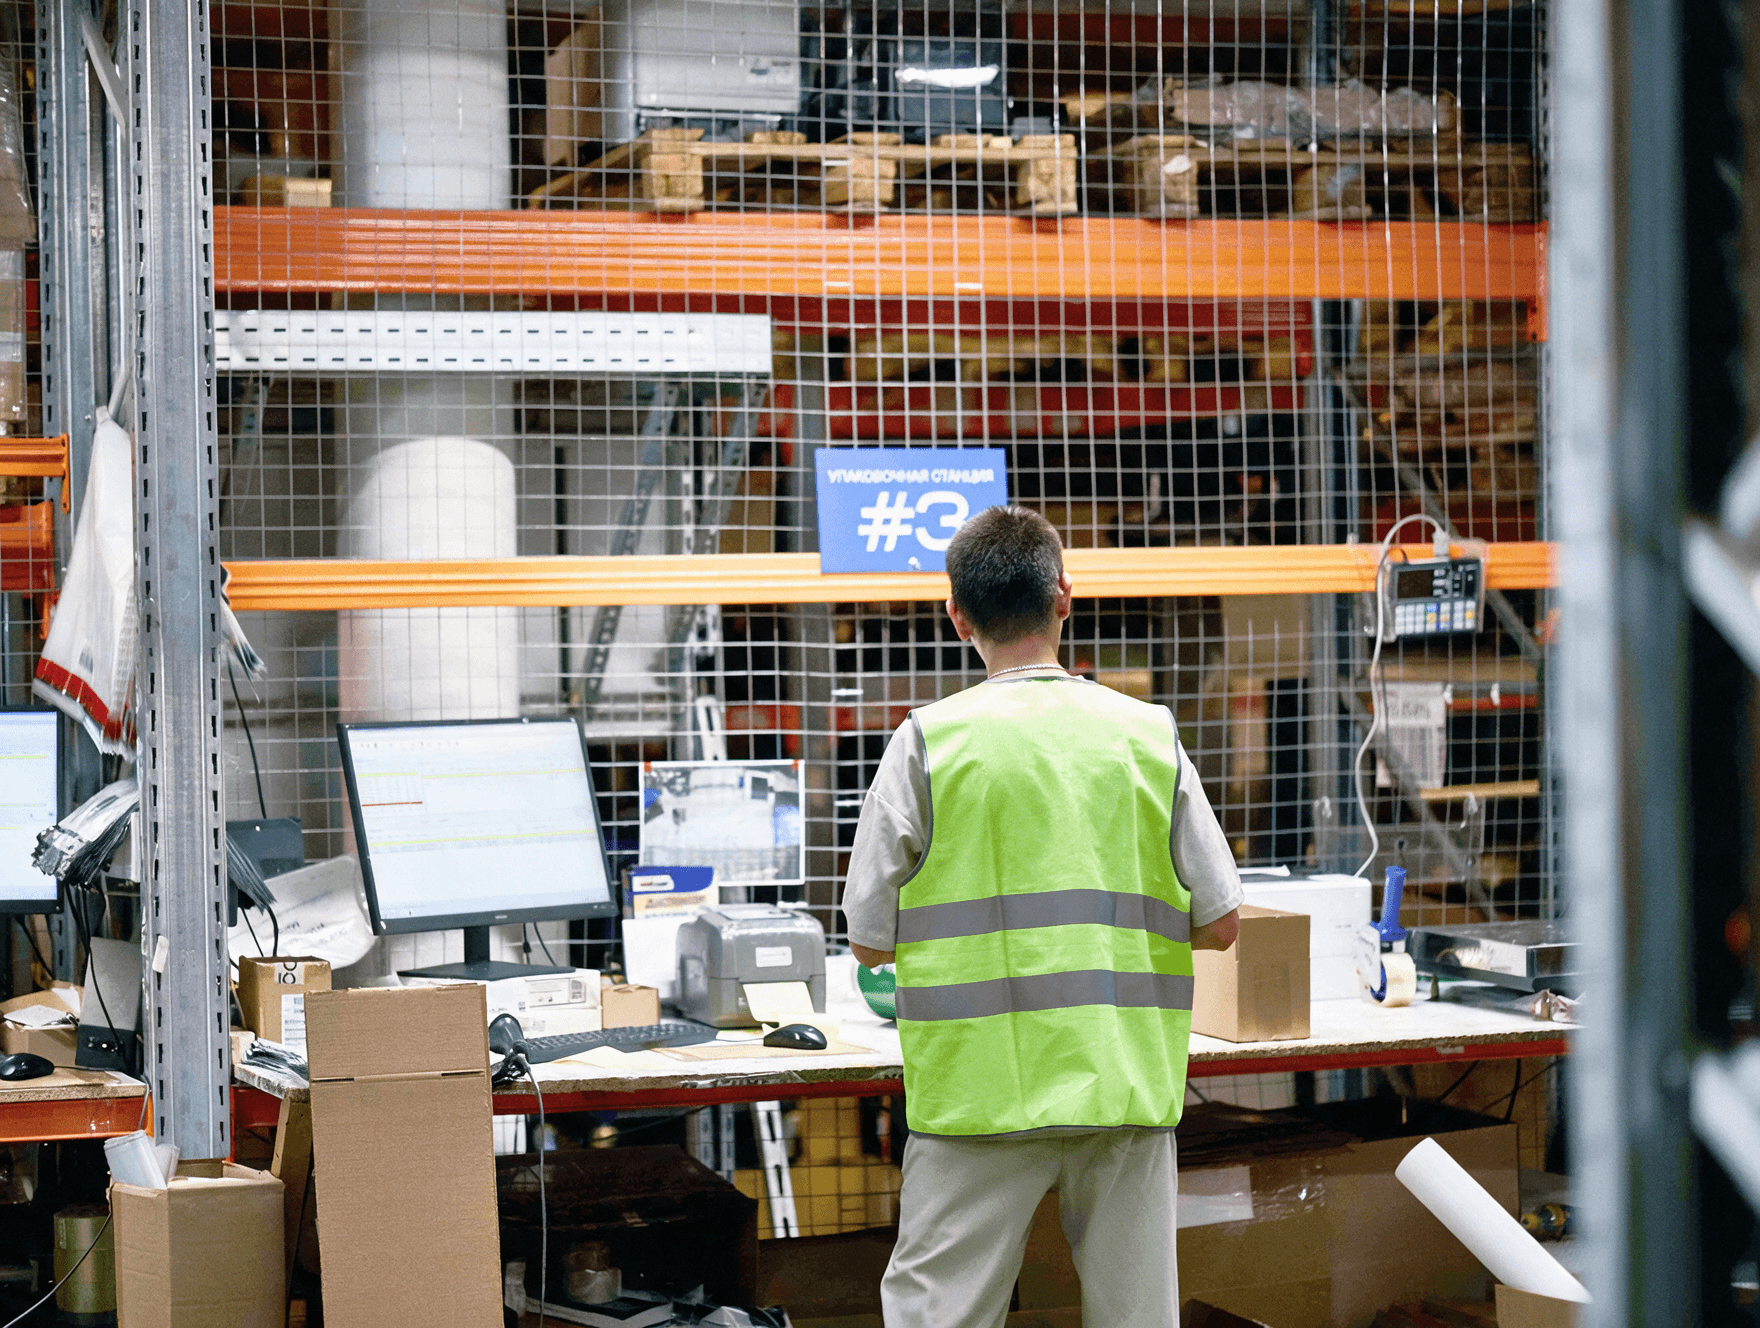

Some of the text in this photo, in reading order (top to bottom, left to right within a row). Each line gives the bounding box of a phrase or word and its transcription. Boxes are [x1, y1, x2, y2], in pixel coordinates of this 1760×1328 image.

[827, 468, 995, 484] УПАКОВОЧНАЯ СТАНЦИЯ
[858, 490, 969, 552] #3
